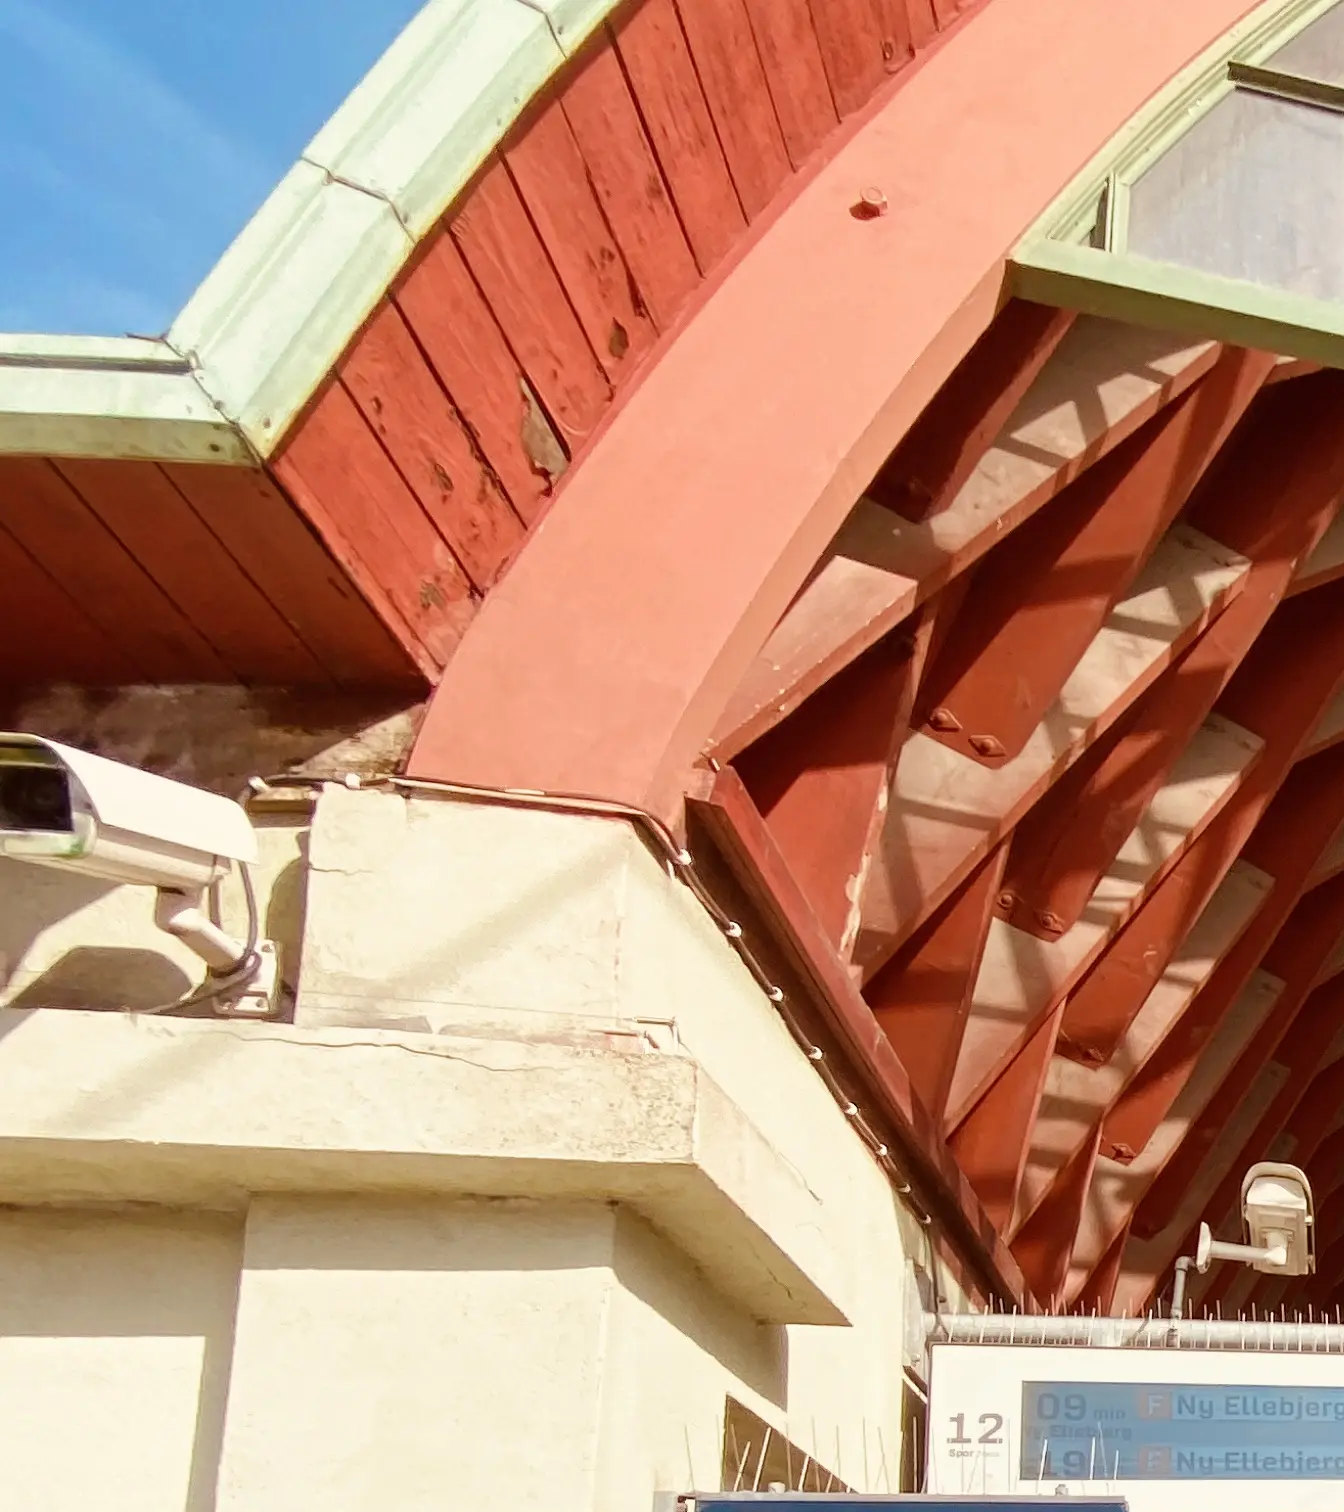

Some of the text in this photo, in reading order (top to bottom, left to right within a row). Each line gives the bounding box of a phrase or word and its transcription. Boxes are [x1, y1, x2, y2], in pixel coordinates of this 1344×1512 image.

[1036, 1393, 1087, 1421] 09
[1177, 1395, 1213, 1418] Ny
[946, 1412, 1004, 1444] 12
[1176, 1452, 1213, 1473] Ny
